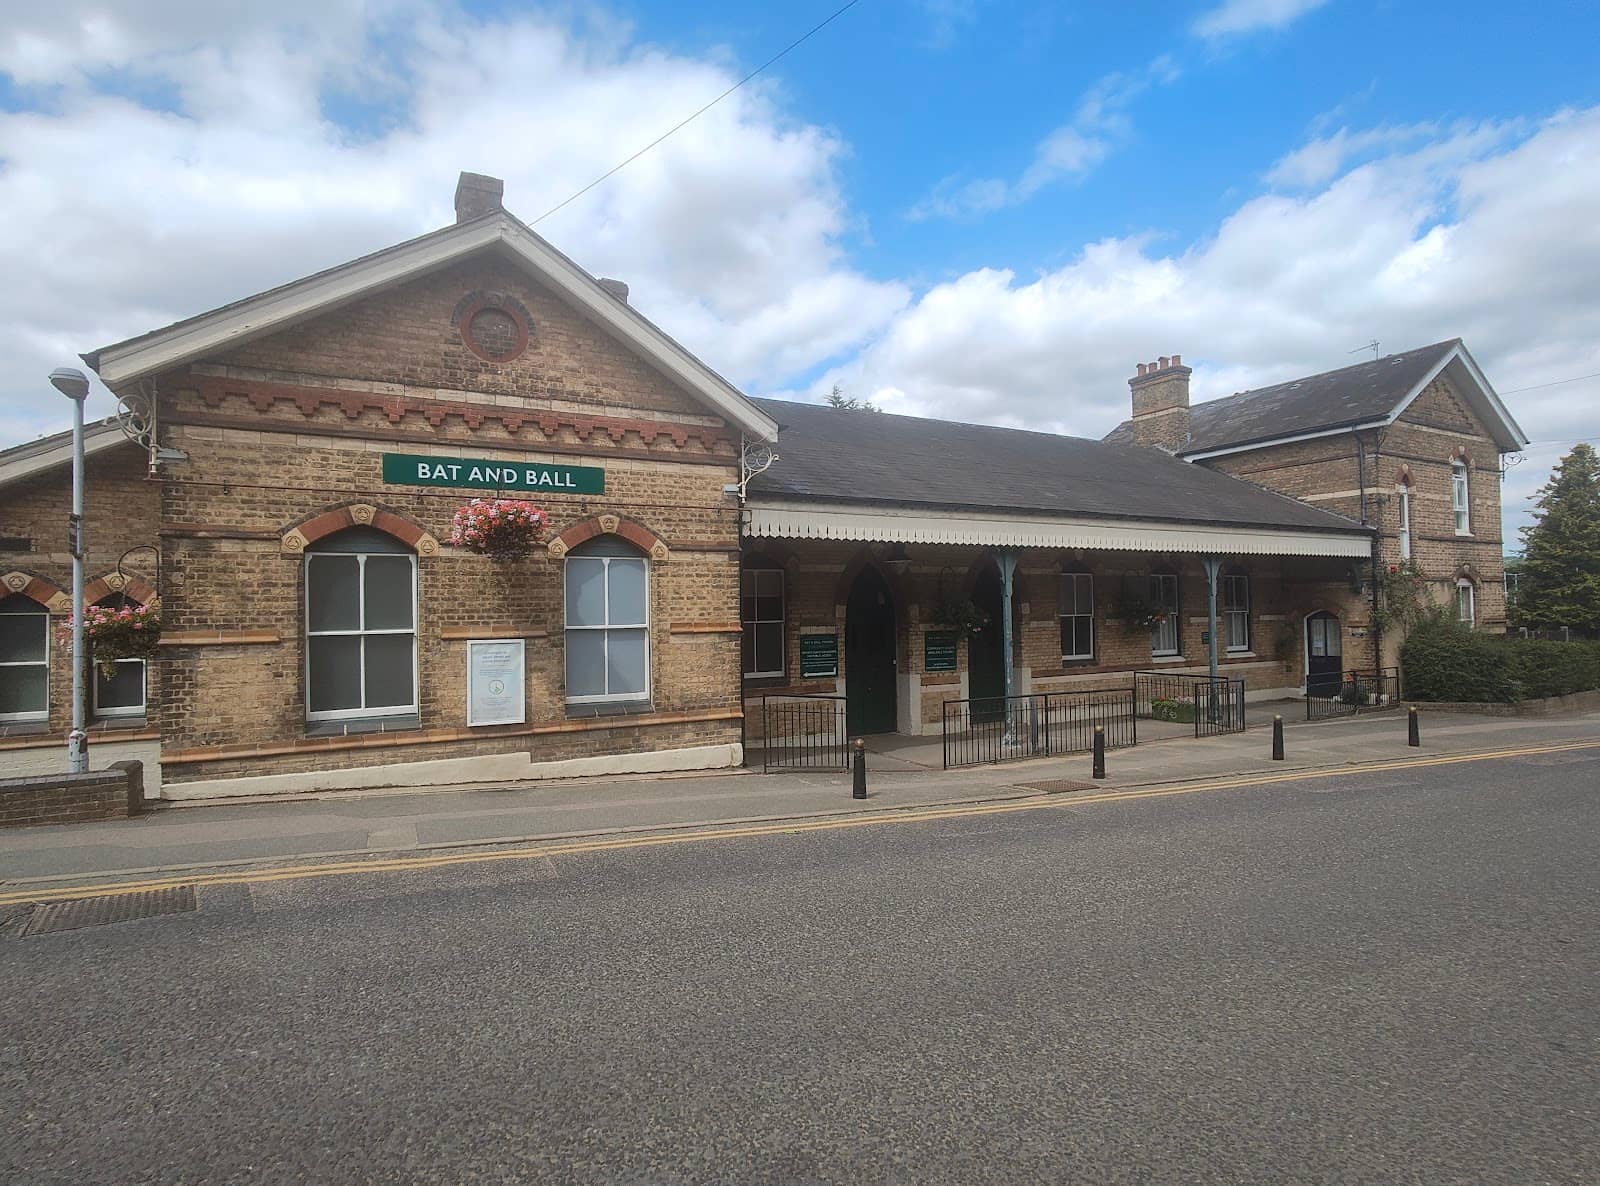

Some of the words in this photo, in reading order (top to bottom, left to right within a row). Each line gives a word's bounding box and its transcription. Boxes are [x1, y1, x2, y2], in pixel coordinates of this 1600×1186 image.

[417, 463, 462, 481] BAT
[468, 466, 518, 484] AND
[525, 469, 577, 487] BALL
